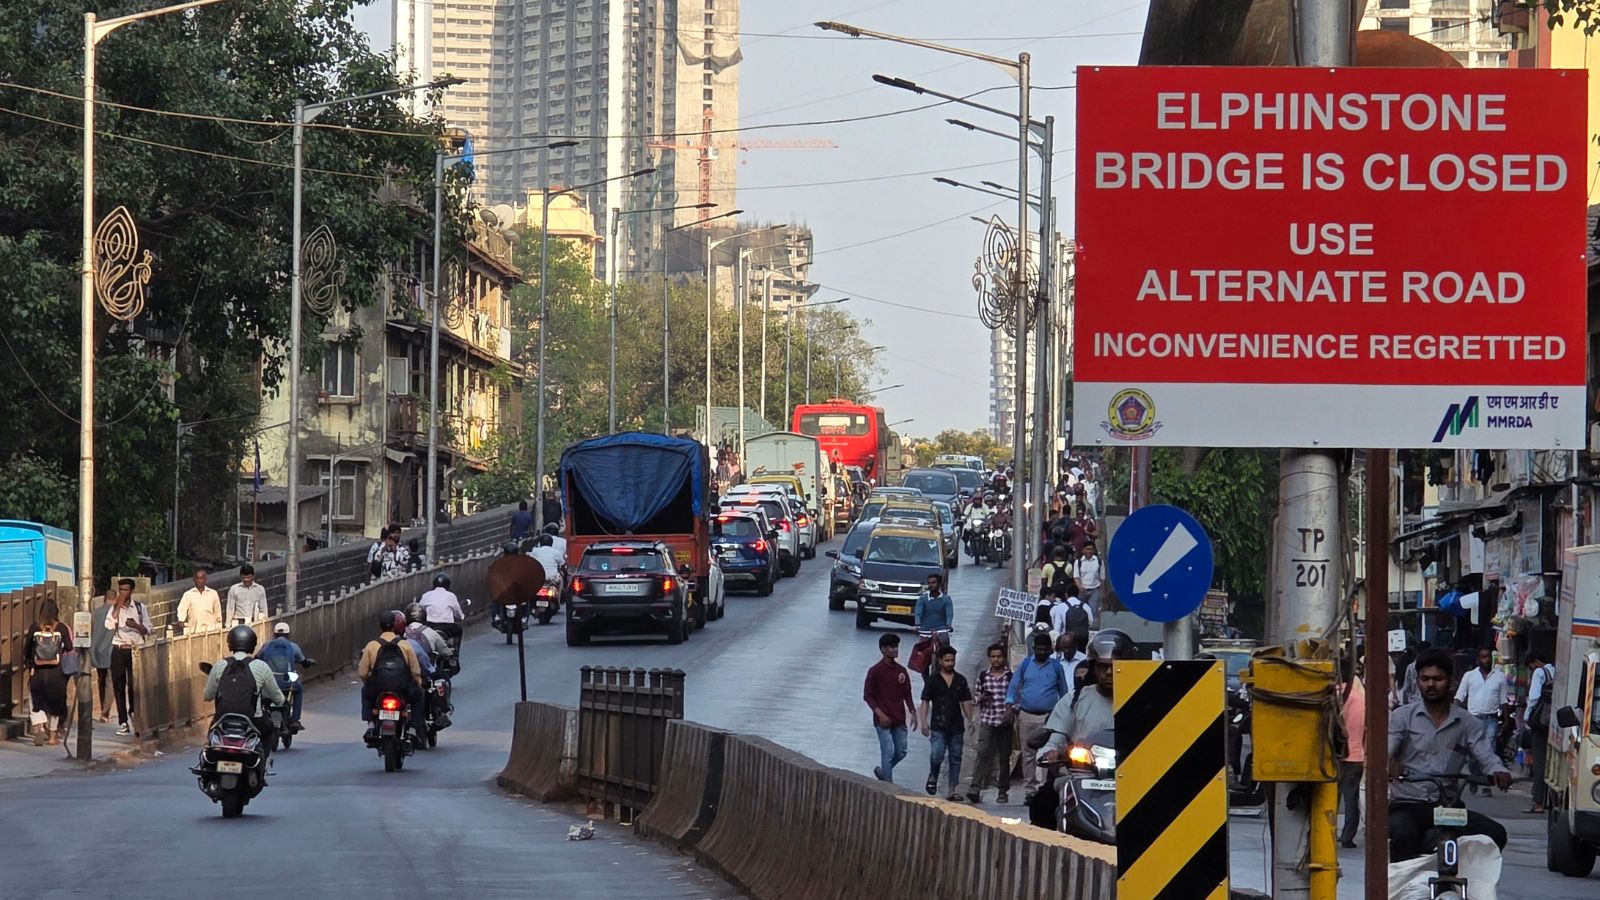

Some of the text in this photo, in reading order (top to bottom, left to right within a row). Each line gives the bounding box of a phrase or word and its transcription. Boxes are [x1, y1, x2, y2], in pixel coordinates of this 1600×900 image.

[1157, 92, 1506, 131] ELPHINSTONE
[1095, 151, 1568, 192] BRIDGE IS CLOSED
[1289, 222, 1374, 256] USE
[1136, 269, 1525, 304] ALTERNATE ROAD
[1094, 332, 1566, 360] INCONVENIENCE REGRETTED
[1487, 415, 1533, 428] MMRDA
[1297, 528, 1325, 553] TP
[1296, 563, 1326, 588] 201
